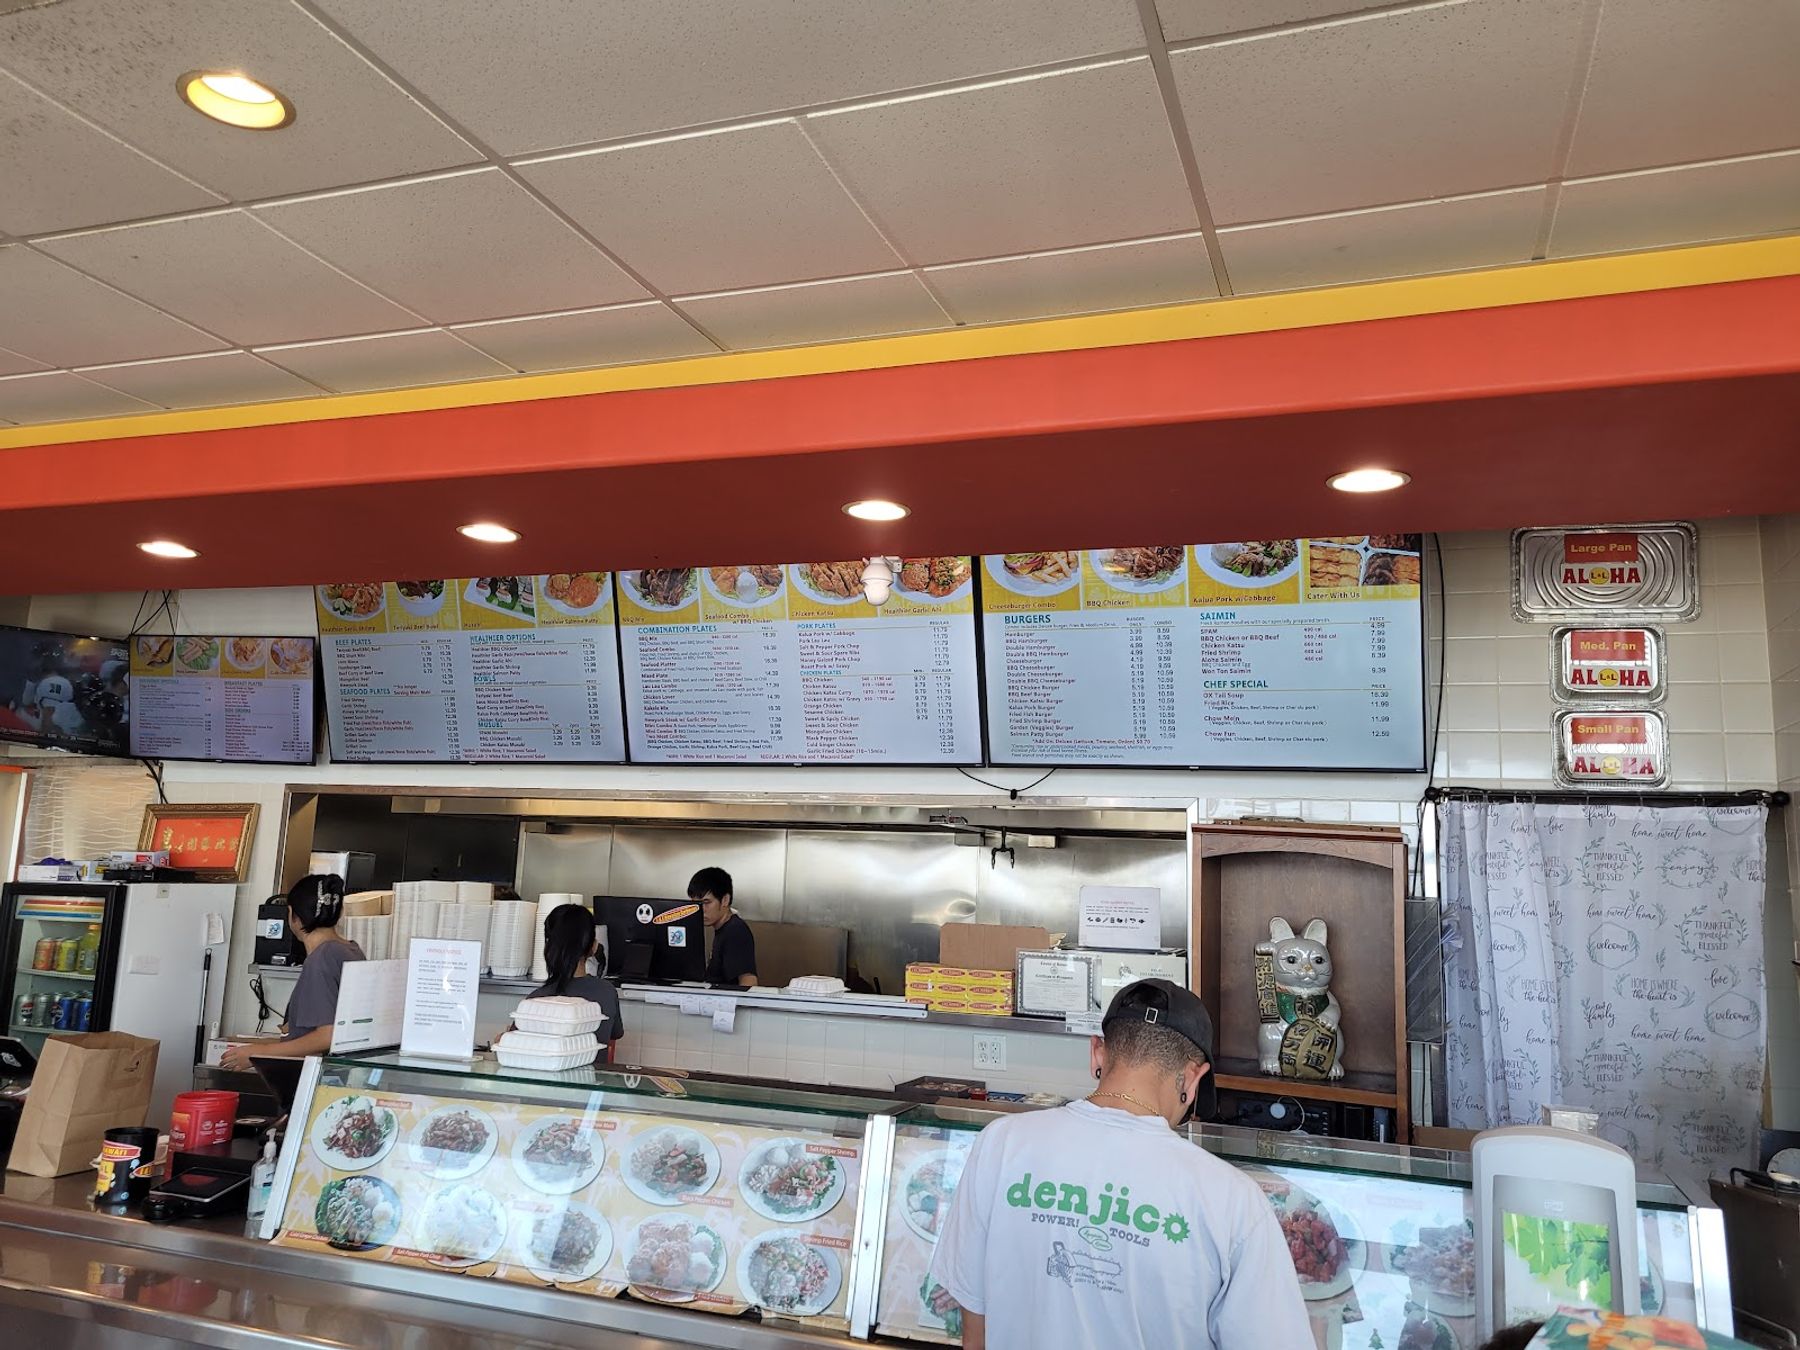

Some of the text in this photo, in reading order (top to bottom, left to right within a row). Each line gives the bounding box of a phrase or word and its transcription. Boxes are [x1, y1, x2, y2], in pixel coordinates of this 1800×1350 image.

[1571, 544, 1605, 554] Large
[1004, 615, 1051, 624] BURGERS
[1200, 612, 1236, 620] SAIMIN
[638, 626, 690, 634] COMBINATION
[1580, 642, 1636, 650] Med. Pan
[1203, 680, 1268, 688] CHEF SPECIAL
[1577, 724, 1639, 733] Small Pan
[1632, 823, 1707, 840] home sweet home
[1593, 853, 1628, 862] THANKFUL
[1596, 873, 1624, 881] BLESSED
[1587, 903, 1657, 921] home sweet home
[1695, 921, 1732, 929] THANKFUL
[1596, 939, 1628, 951] welcome
[1698, 942, 1728, 950] BLESSED
[1632, 978, 1649, 991] HOME
[1657, 979, 1679, 991] WHERE
[1585, 1002, 1615, 1029] family
[1715, 1008, 1751, 1022] welcome
[1526, 1028, 1546, 1044] home
[1631, 1024, 1706, 1042] home sweet home
[1593, 1054, 1628, 1062] THANKFUL
[1596, 1074, 1624, 1082] BLESSED
[1634, 1104, 1655, 1120] home
[1007, 1172, 1191, 1244] denjico
[1031, 1212, 1080, 1228] POWER!
[1109, 1227, 1150, 1247] TOOLS
